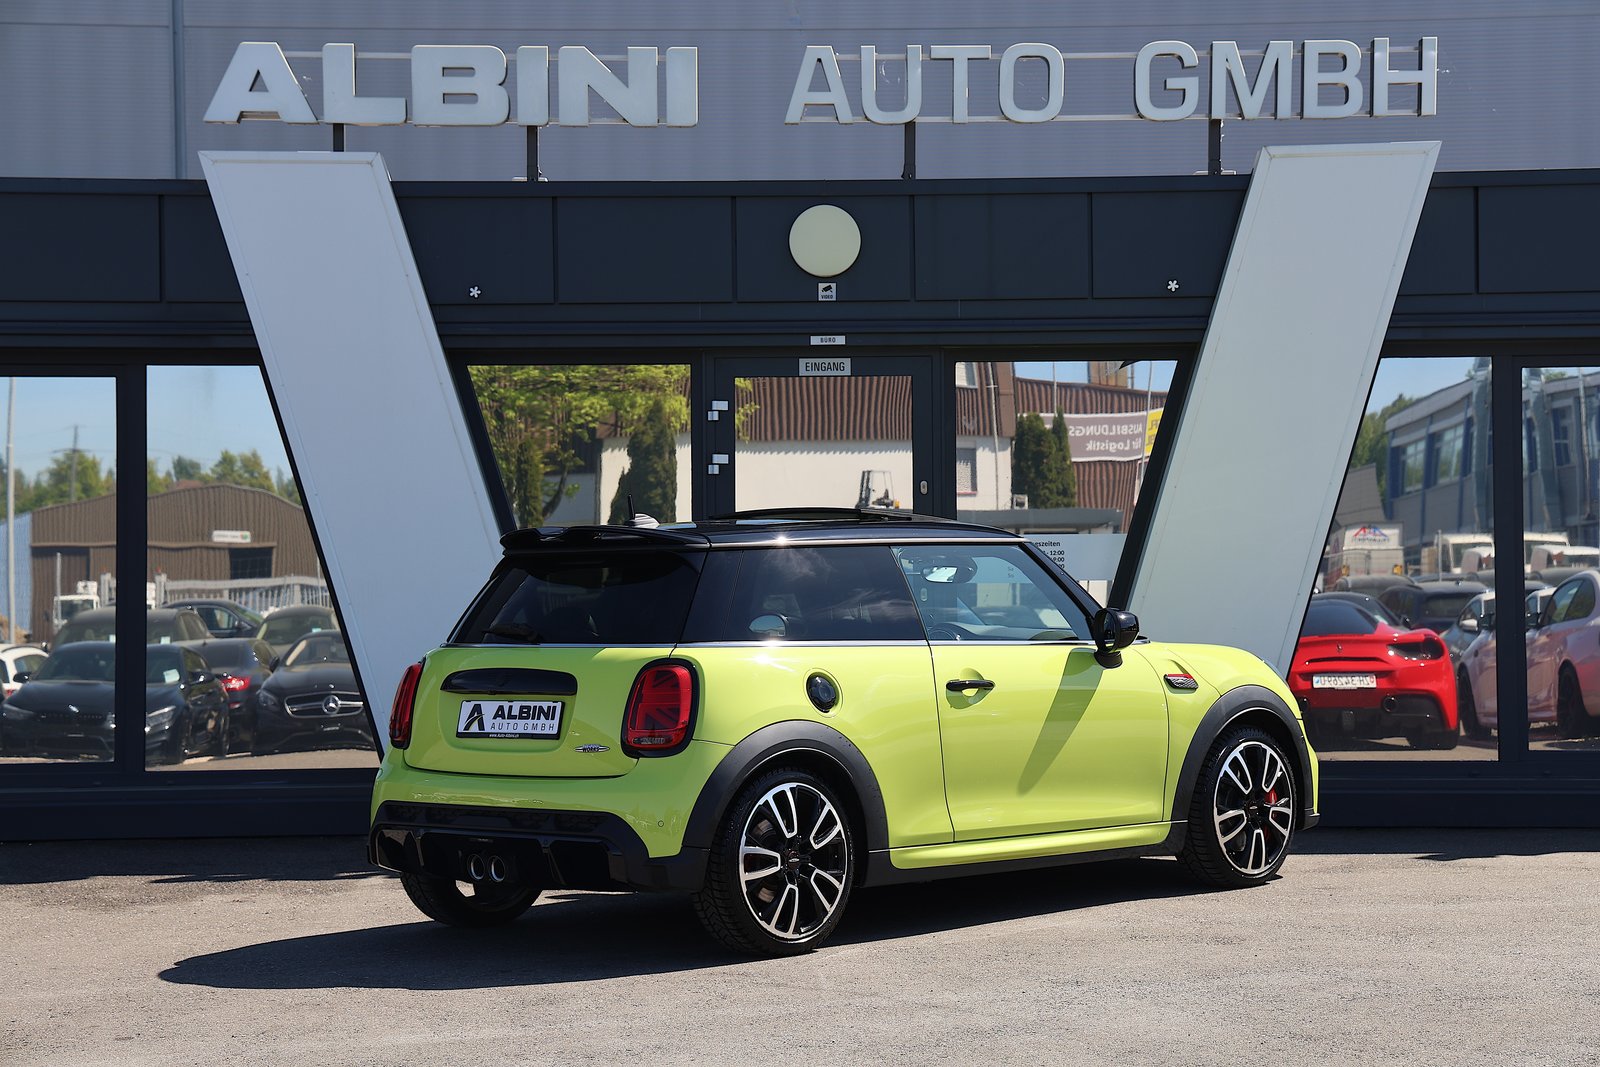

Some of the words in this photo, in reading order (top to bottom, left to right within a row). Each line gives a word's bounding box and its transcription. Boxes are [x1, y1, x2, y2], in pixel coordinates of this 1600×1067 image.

[203, 41, 699, 127] ALBINI
[784, 42, 1065, 125] AUTO
[1134, 36, 1438, 121] GMBH
[805, 361, 845, 372] EINGANG
[492, 704, 557, 720] ALBINI
[490, 722, 518, 731] AUTO
[523, 723, 554, 731] GMBH
